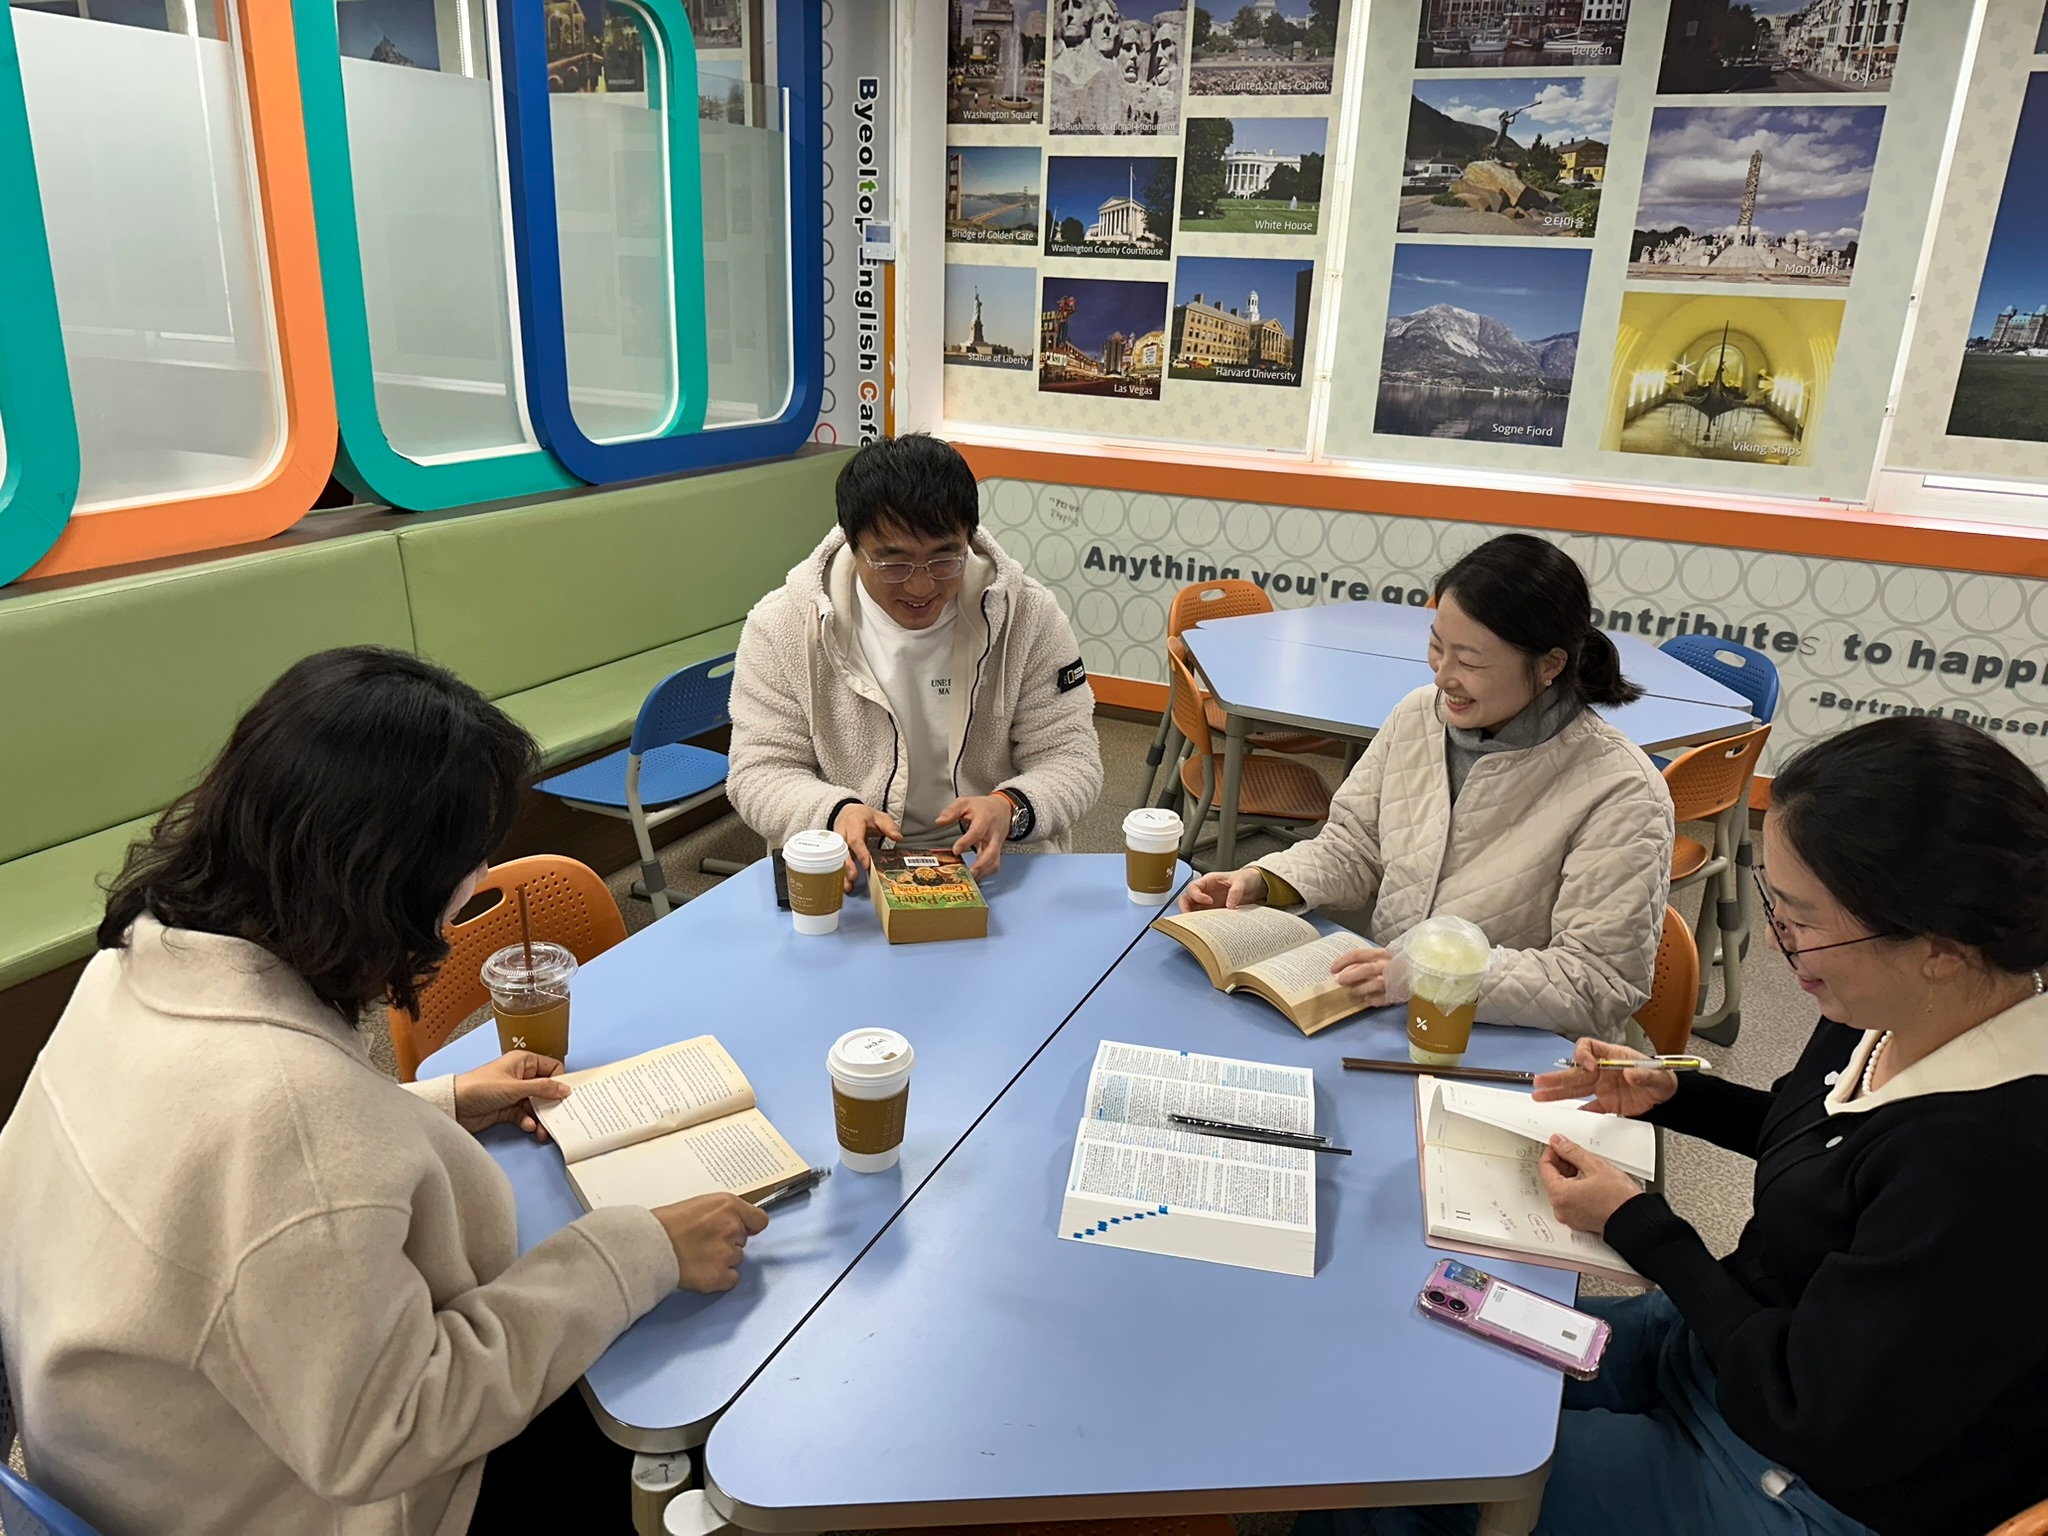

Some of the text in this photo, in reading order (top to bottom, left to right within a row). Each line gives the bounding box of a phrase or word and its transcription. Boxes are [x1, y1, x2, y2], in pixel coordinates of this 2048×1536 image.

[1571, 45, 1612, 58] Bergen
[1231, 80, 1328, 92] United States Capitol
[963, 110, 1039, 121] Washington Square
[1135, 122, 1176, 132] Monument
[1255, 220, 1313, 231] White House
[1541, 216, 1585, 230] 오타마을
[952, 229, 1034, 241] Bridge of Golden Gate
[1051, 244, 1164, 256] Washington County Courthouse
[1784, 262, 1839, 276] Monolith
[967, 352, 1029, 367] Statue of Liberty
[1215, 366, 1297, 383] Harvard University
[1113, 384, 1154, 396] Las Vegas
[1491, 422, 1554, 437] Sogne Fjord
[1732, 441, 1802, 457] Viking Ships
[1590, 607, 1820, 656] ontributes
[1843, 632, 1893, 664] to
[896, 894, 939, 905] Potter
